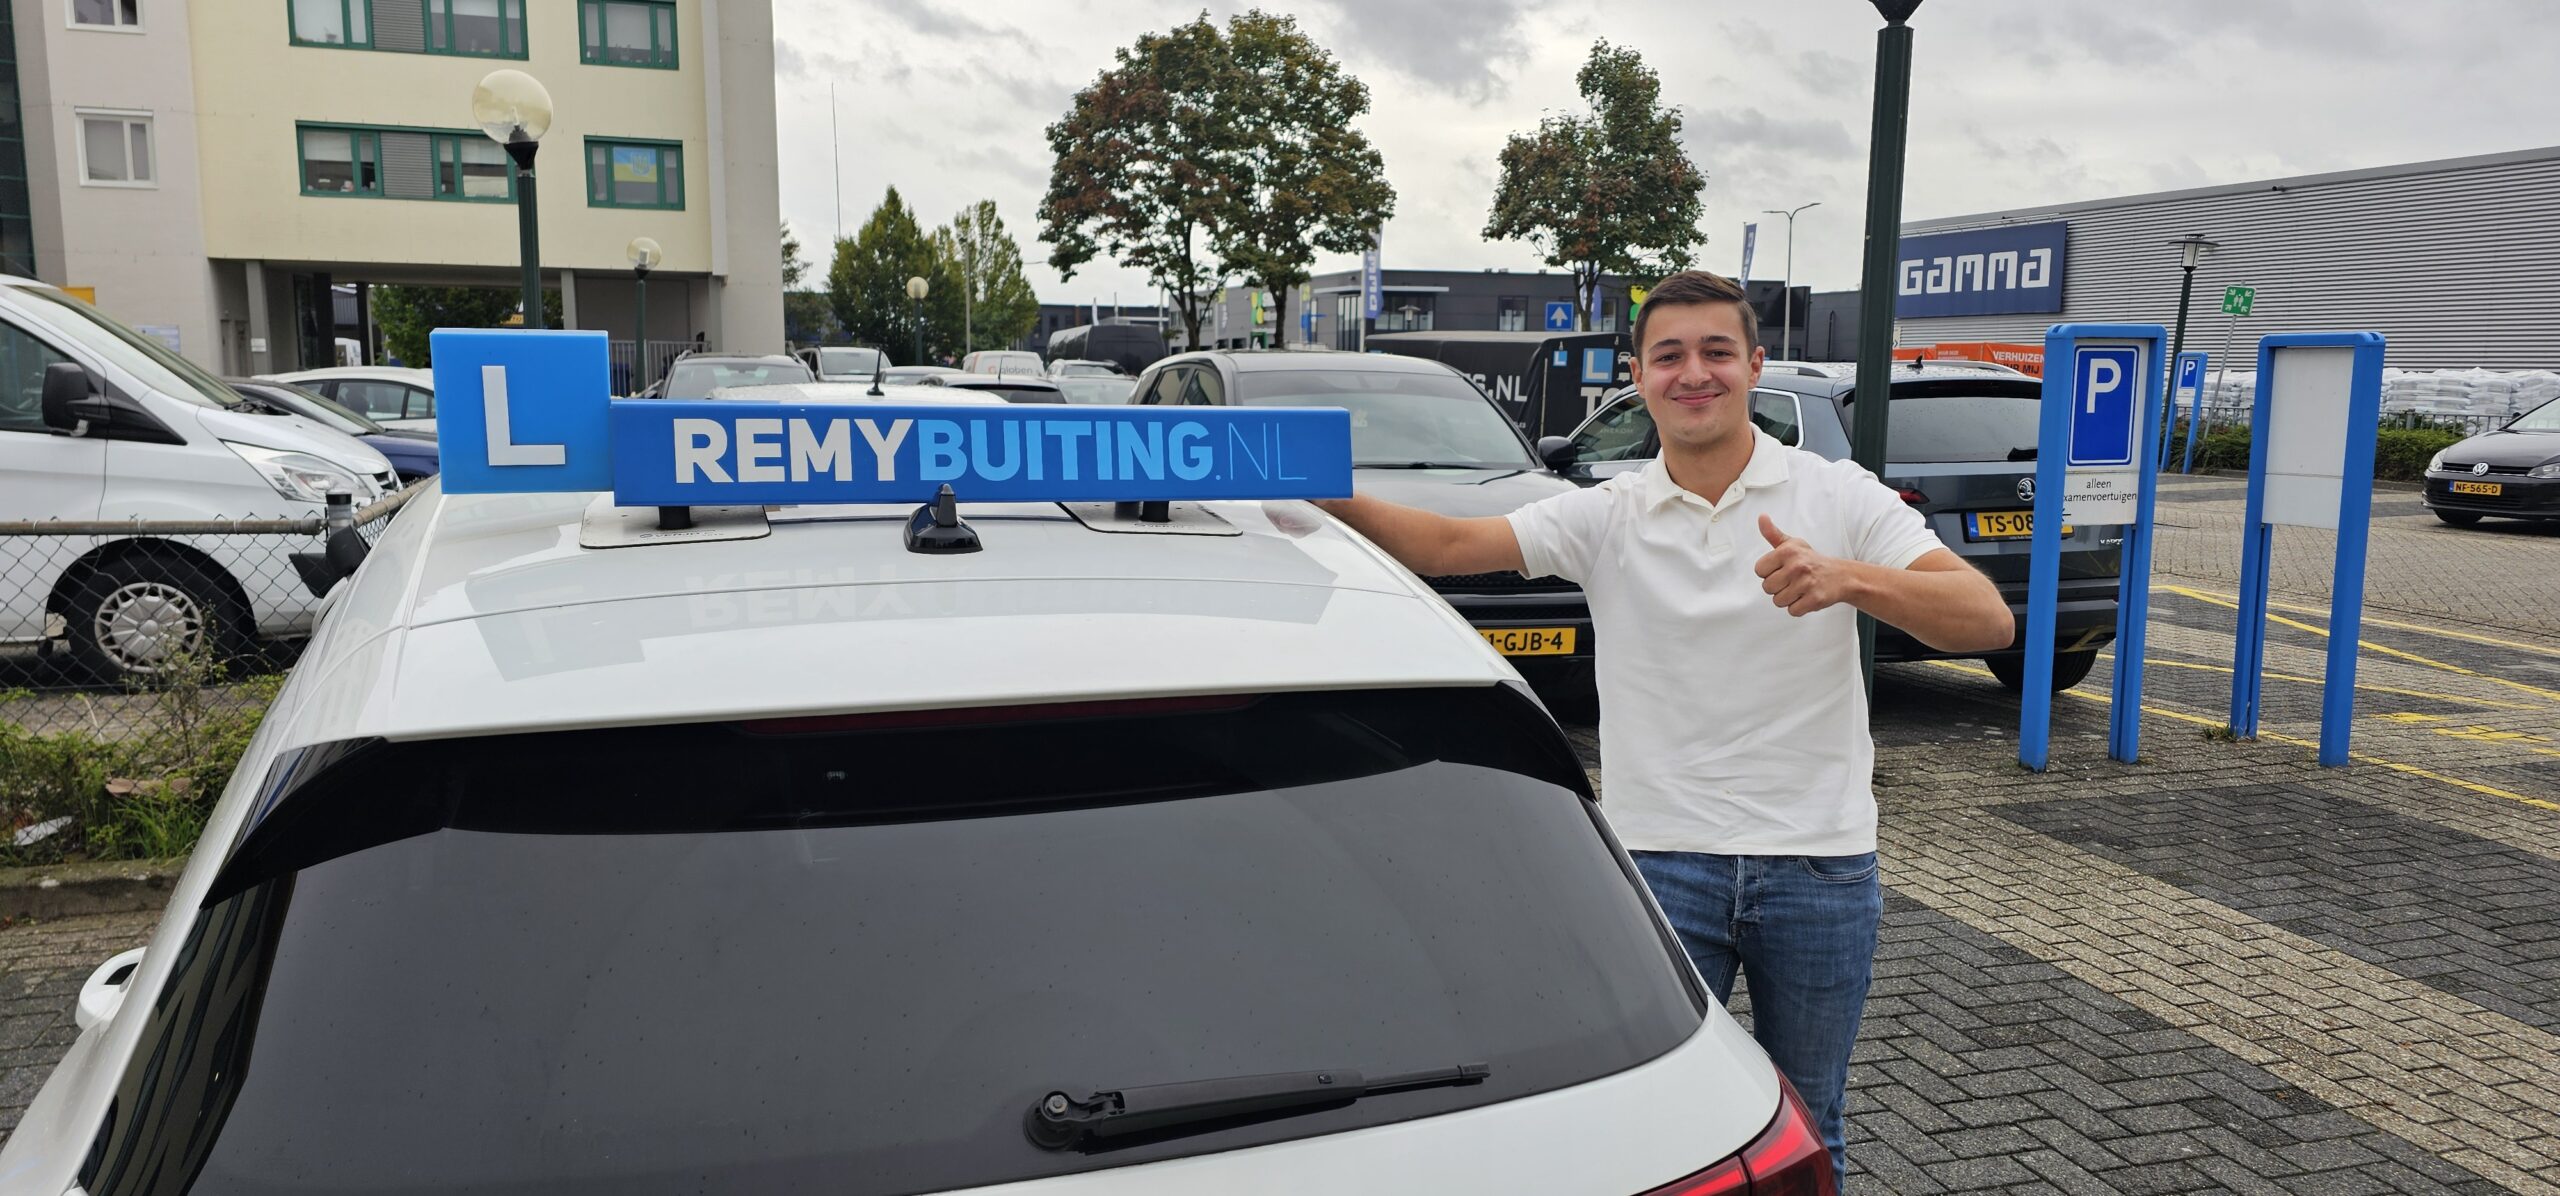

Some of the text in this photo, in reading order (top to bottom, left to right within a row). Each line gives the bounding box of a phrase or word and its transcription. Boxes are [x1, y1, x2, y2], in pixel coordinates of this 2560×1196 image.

[1899, 248, 2051, 296] GAMMA
[1585, 350, 1609, 380] L
[2022, 364, 2040, 374] MIJ
[2185, 361, 2196, 376] P
[2086, 358, 2122, 414] P
[481, 365, 566, 467] L
[673, 418, 1307, 483] REMYBUITING.NL
[2086, 478, 2112, 490] alleen
[2455, 482, 2498, 494] NF-565-D
[2063, 491, 2138, 504] xamenvoertuigen
[1983, 514, 2034, 533] TS-08
[1480, 631, 1563, 652] 1-GJB-4
